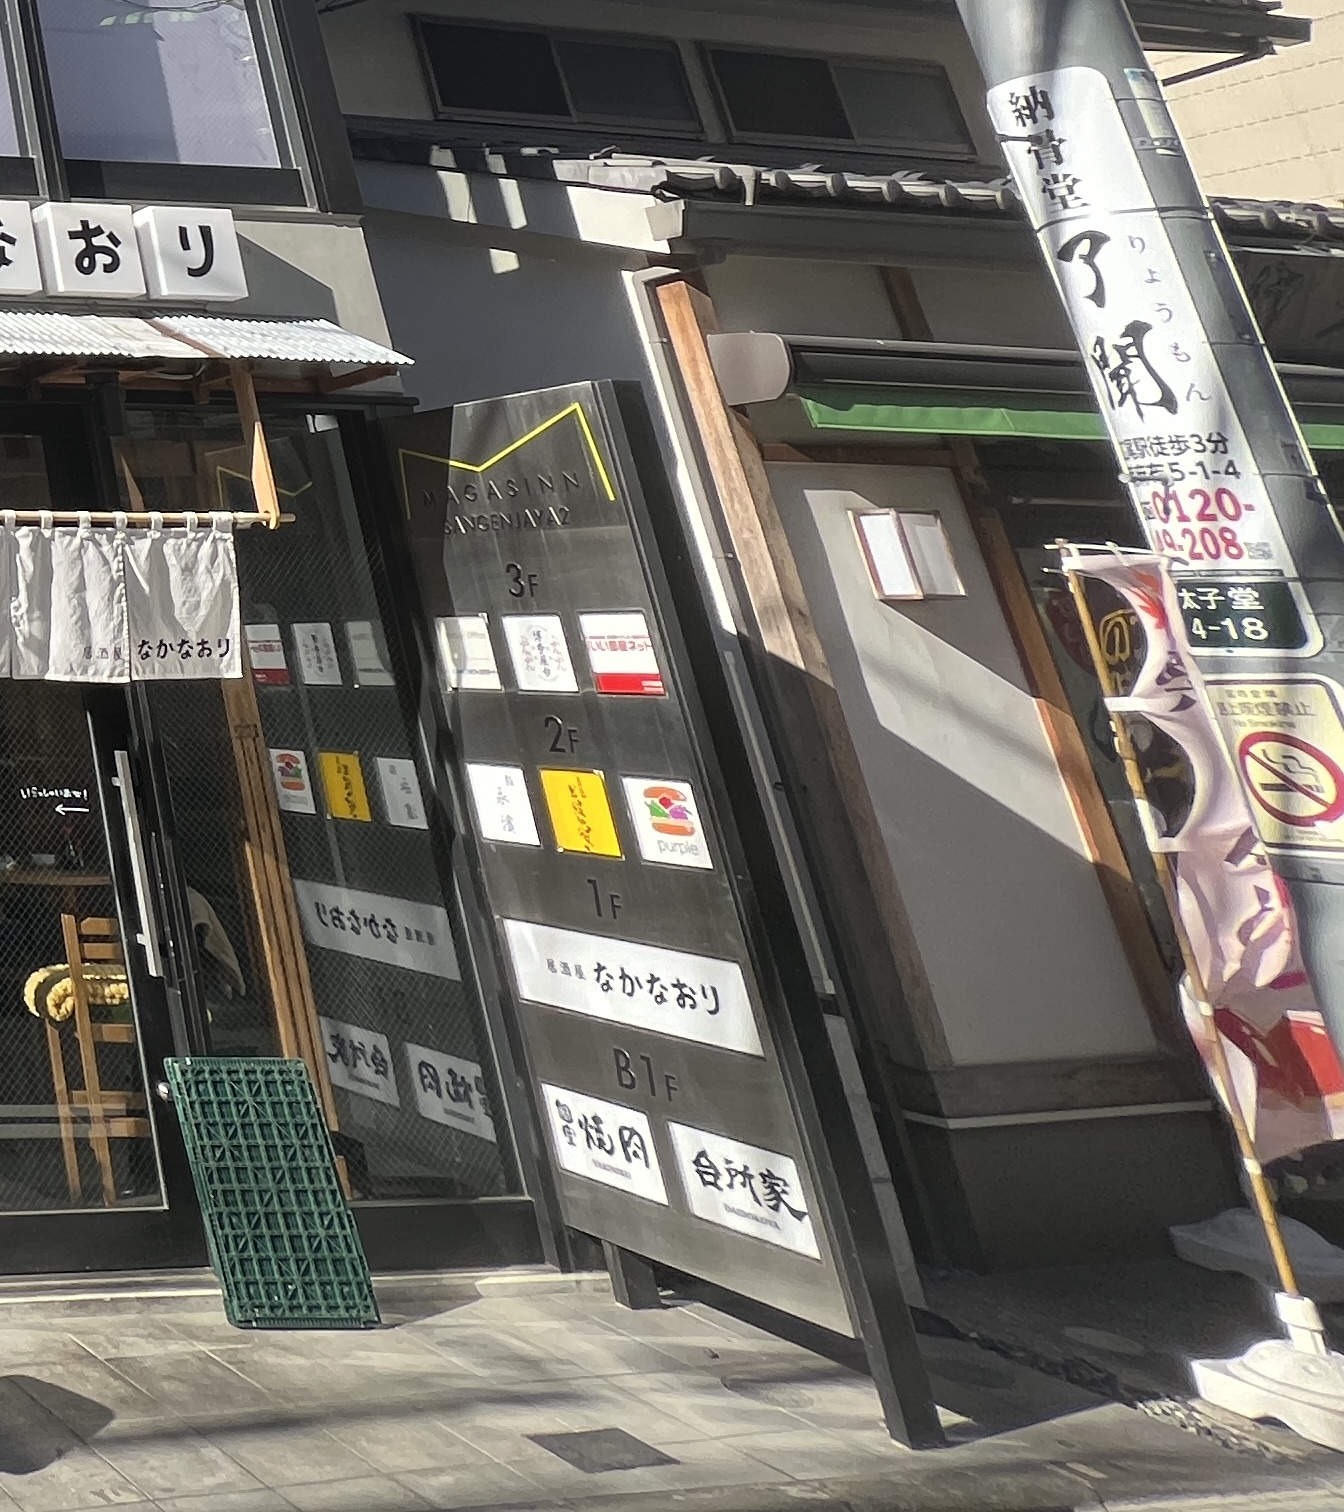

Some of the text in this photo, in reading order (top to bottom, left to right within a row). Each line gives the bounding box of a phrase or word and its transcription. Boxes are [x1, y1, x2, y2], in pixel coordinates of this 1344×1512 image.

[1007, 85, 1093, 211] 納骨堂
[1128, 234, 1212, 403] りょうもん
[422, 471, 581, 506] MAGASINN
[506, 563, 539, 598] 3F
[1178, 586, 1265, 611] 太子堂
[137, 638, 231, 661] なかなおり
[1191, 617, 1269, 640] 4-18
[544, 715, 580, 755] 2F
[587, 879, 622, 921] 1F
[593, 961, 720, 1016] なかなおり
[613, 1048, 678, 1103] B1F
[577, 1113, 650, 1169] 焼肉
[692, 1149, 809, 1222] 台所家
